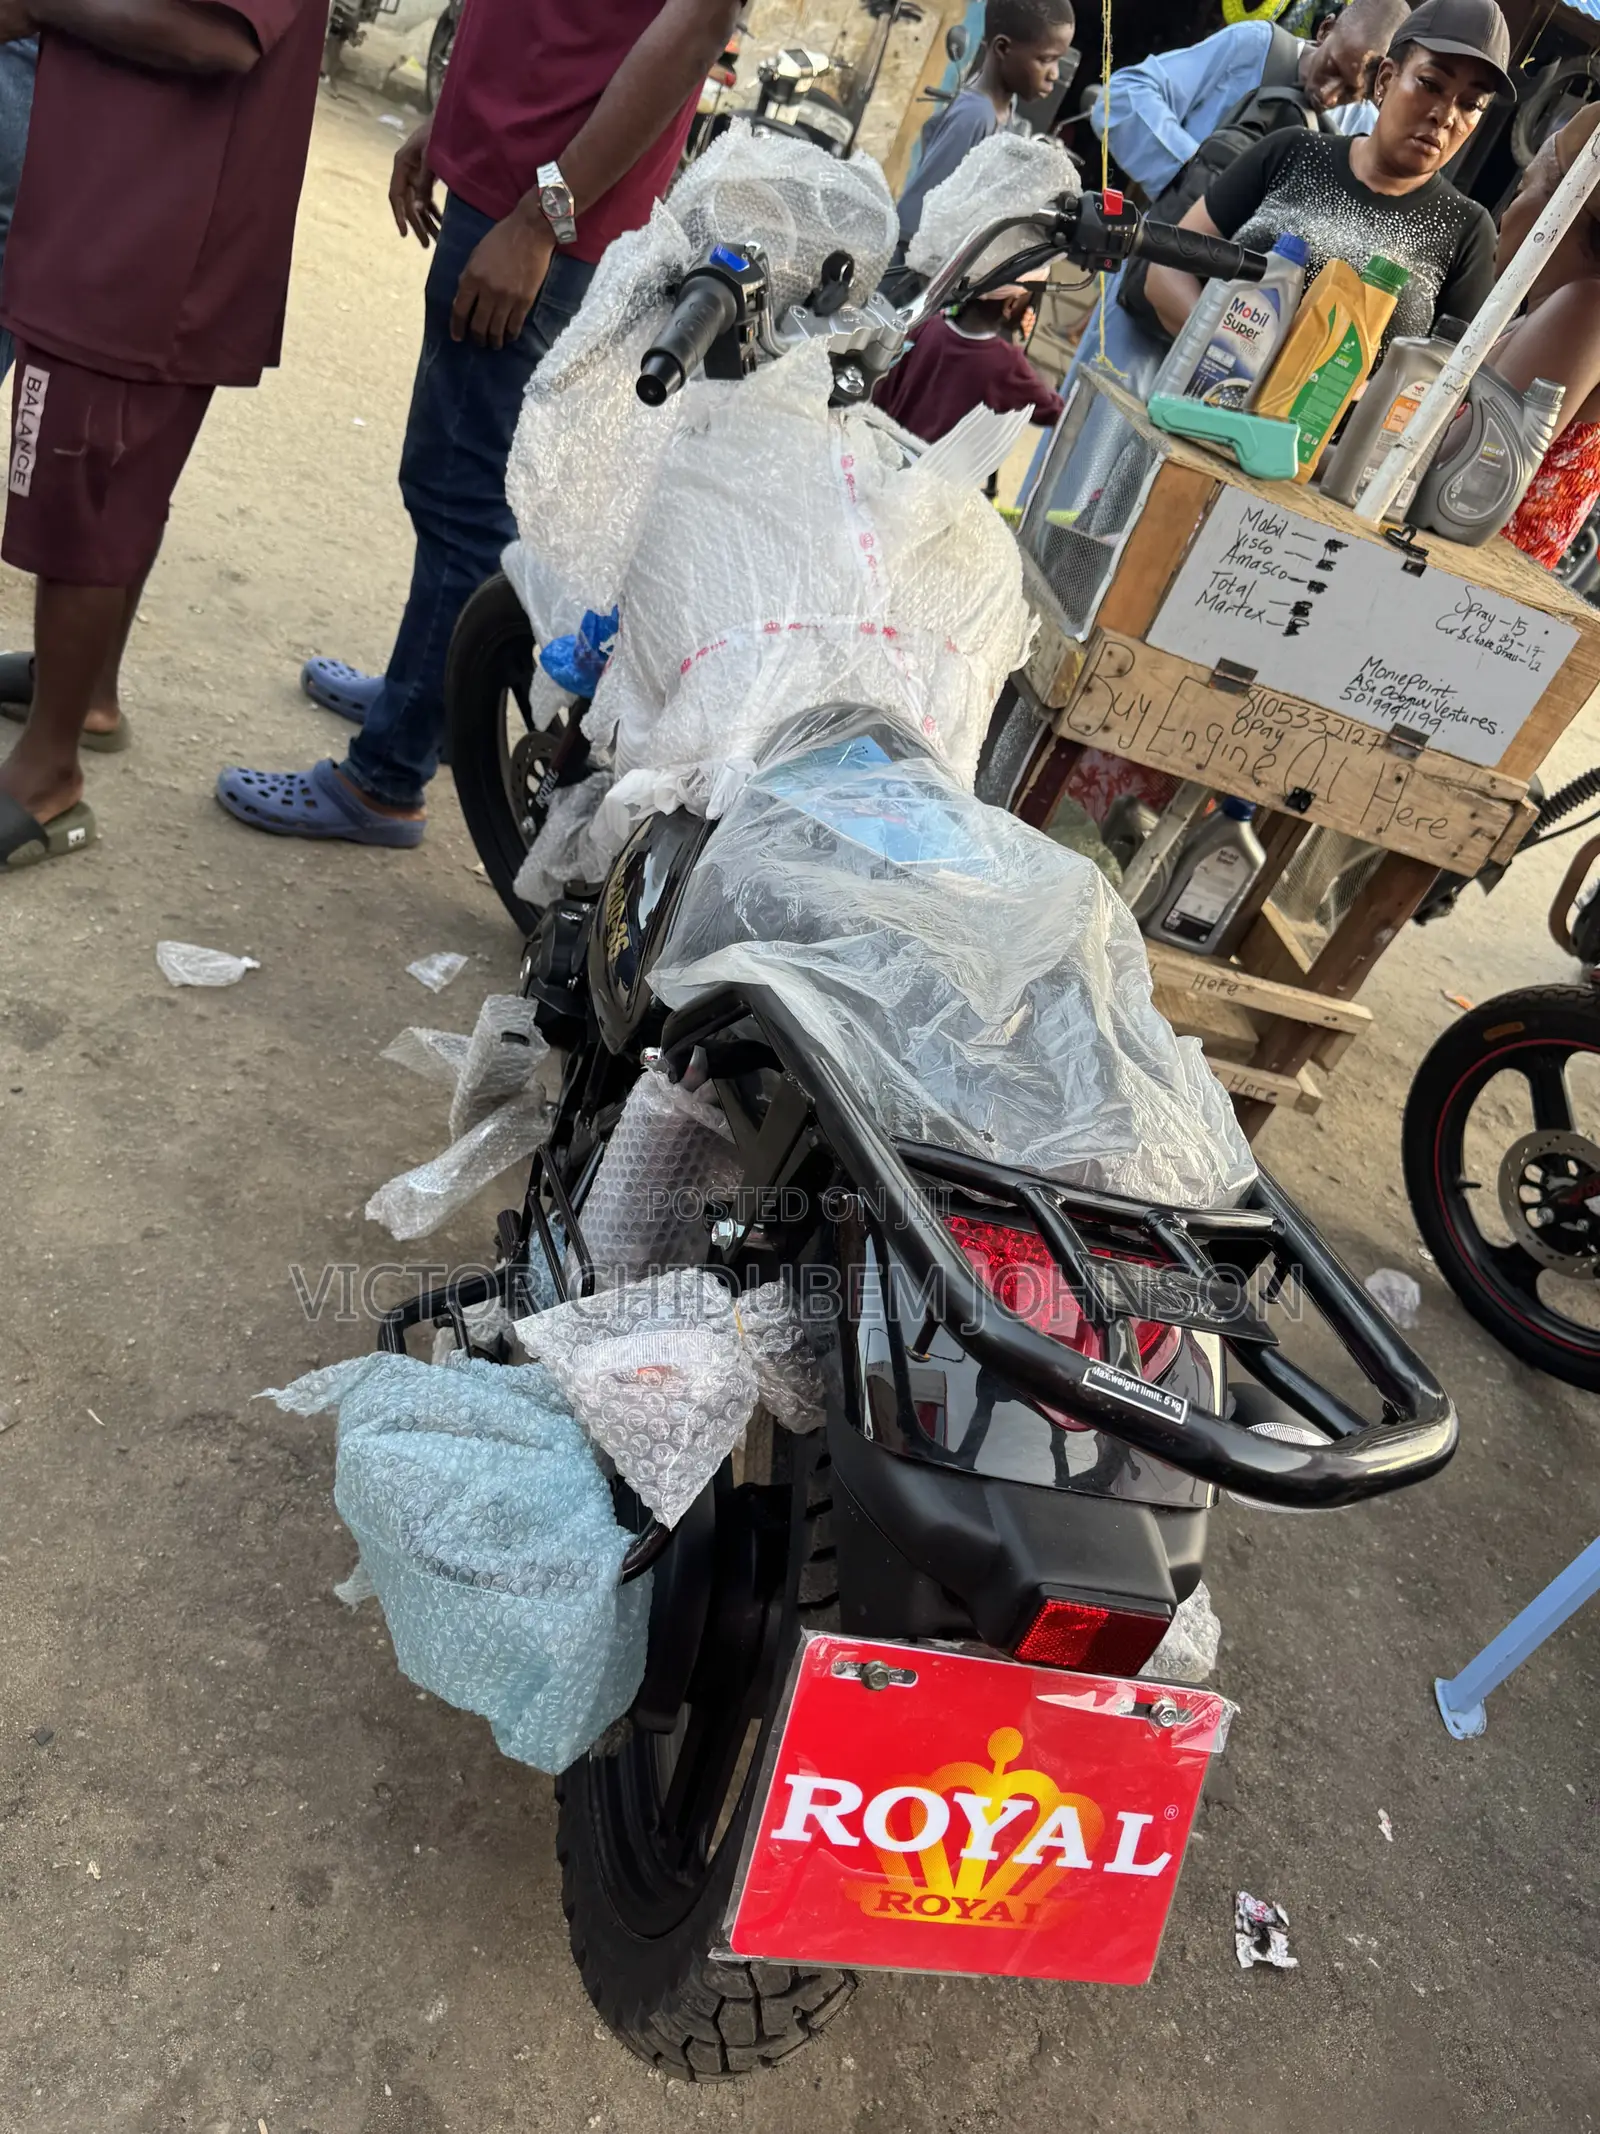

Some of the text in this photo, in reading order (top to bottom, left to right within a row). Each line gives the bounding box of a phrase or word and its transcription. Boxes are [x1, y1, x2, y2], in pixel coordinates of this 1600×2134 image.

[1223, 312, 1261, 340] Super
[1230, 297, 1270, 328] Mobil
[13, 376, 42, 487] BALANCE
[1239, 504, 1289, 539] Mobil
[1209, 571, 1258, 600] Total
[1066, 641, 1152, 750] Buy
[1146, 676, 1277, 787] Engine
[1360, 762, 1449, 840] Here
[770, 1773, 1173, 1878] ROYAL
